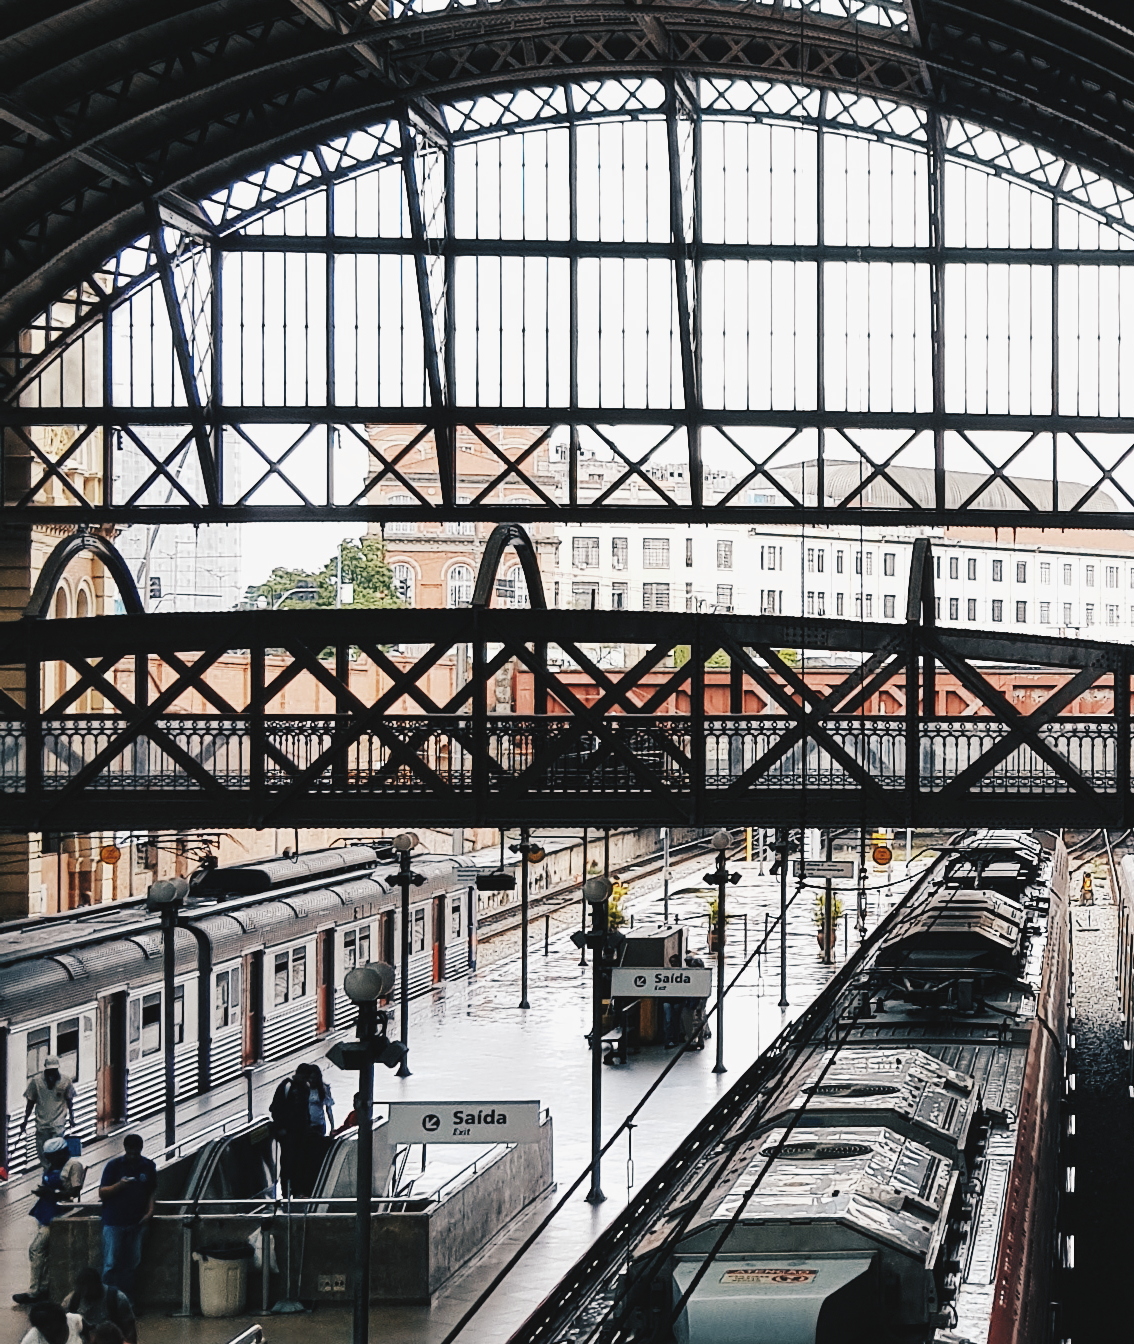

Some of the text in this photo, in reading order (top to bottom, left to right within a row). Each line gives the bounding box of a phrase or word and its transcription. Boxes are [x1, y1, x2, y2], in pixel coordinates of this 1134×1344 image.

[654, 972, 691, 984] Saída
[452, 1109, 507, 1125] Saída
[452, 1128, 471, 1136] Exit
